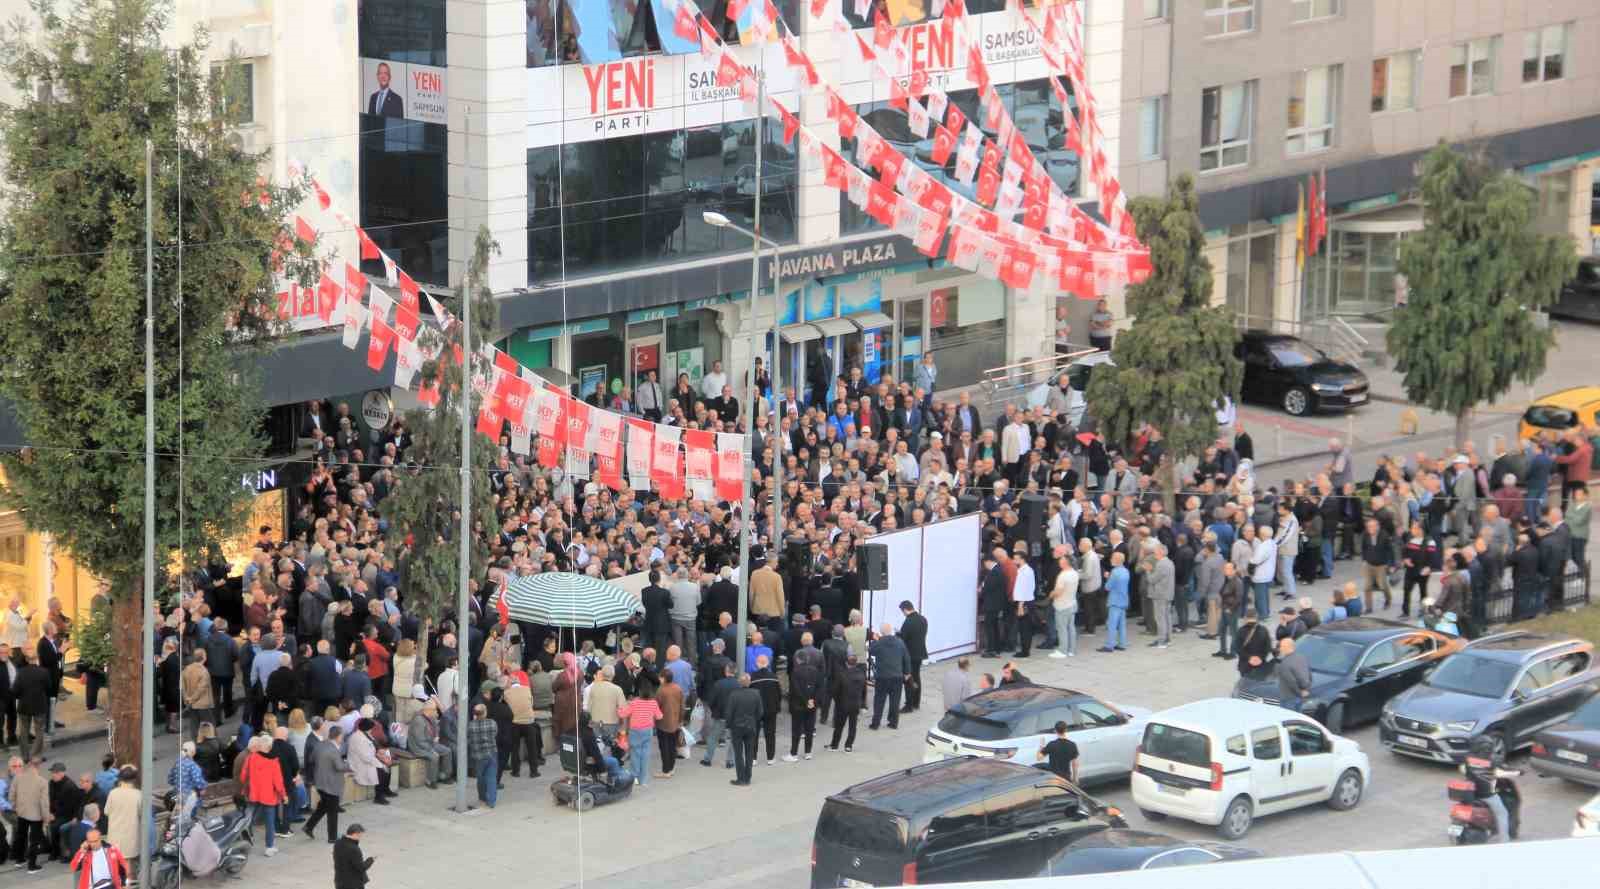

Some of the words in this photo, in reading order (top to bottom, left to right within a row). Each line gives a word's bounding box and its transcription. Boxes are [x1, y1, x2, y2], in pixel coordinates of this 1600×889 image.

[985, 29, 1041, 49] SAMSU
[768, 253, 835, 278] HAVANA
[843, 242, 896, 266] PLAZA
